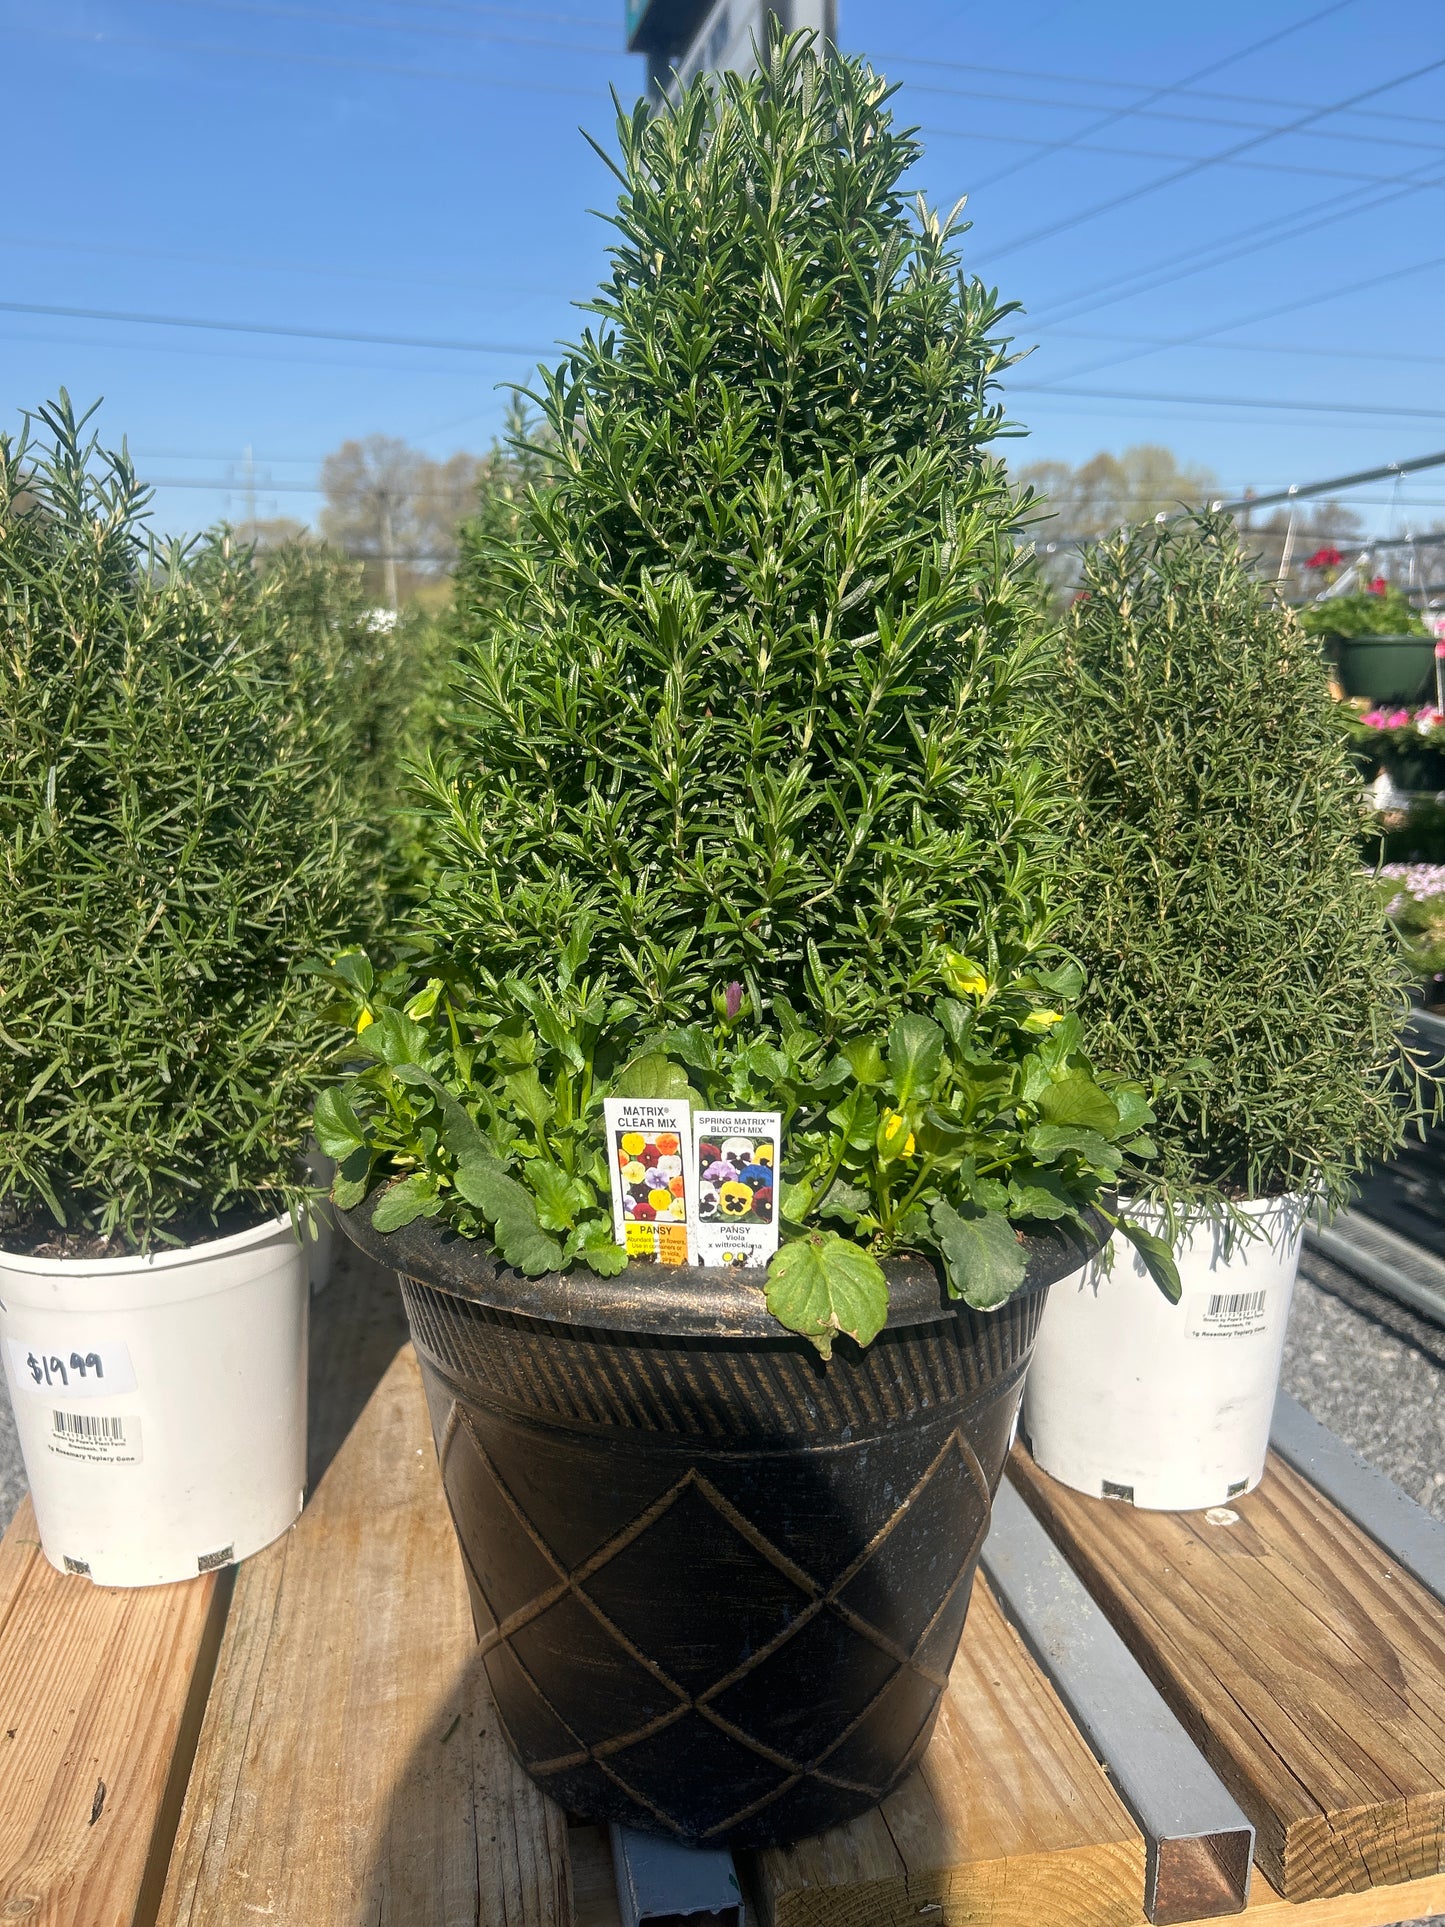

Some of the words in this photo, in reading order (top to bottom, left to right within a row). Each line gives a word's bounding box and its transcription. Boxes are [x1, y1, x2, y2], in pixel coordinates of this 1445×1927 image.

[617, 1117, 654, 1128] CLEAR
[657, 1118, 677, 1129] MIX
[698, 1117, 732, 1126] SPRING
[710, 1125, 746, 1134] BLOTCH
[748, 1126, 763, 1135] MIX
[639, 1225, 672, 1236] PANSY
[720, 1226, 751, 1235] PANSY
[55, 1447, 86, 1460] Rosemary
[88, 1453, 115, 1462] Topiary
